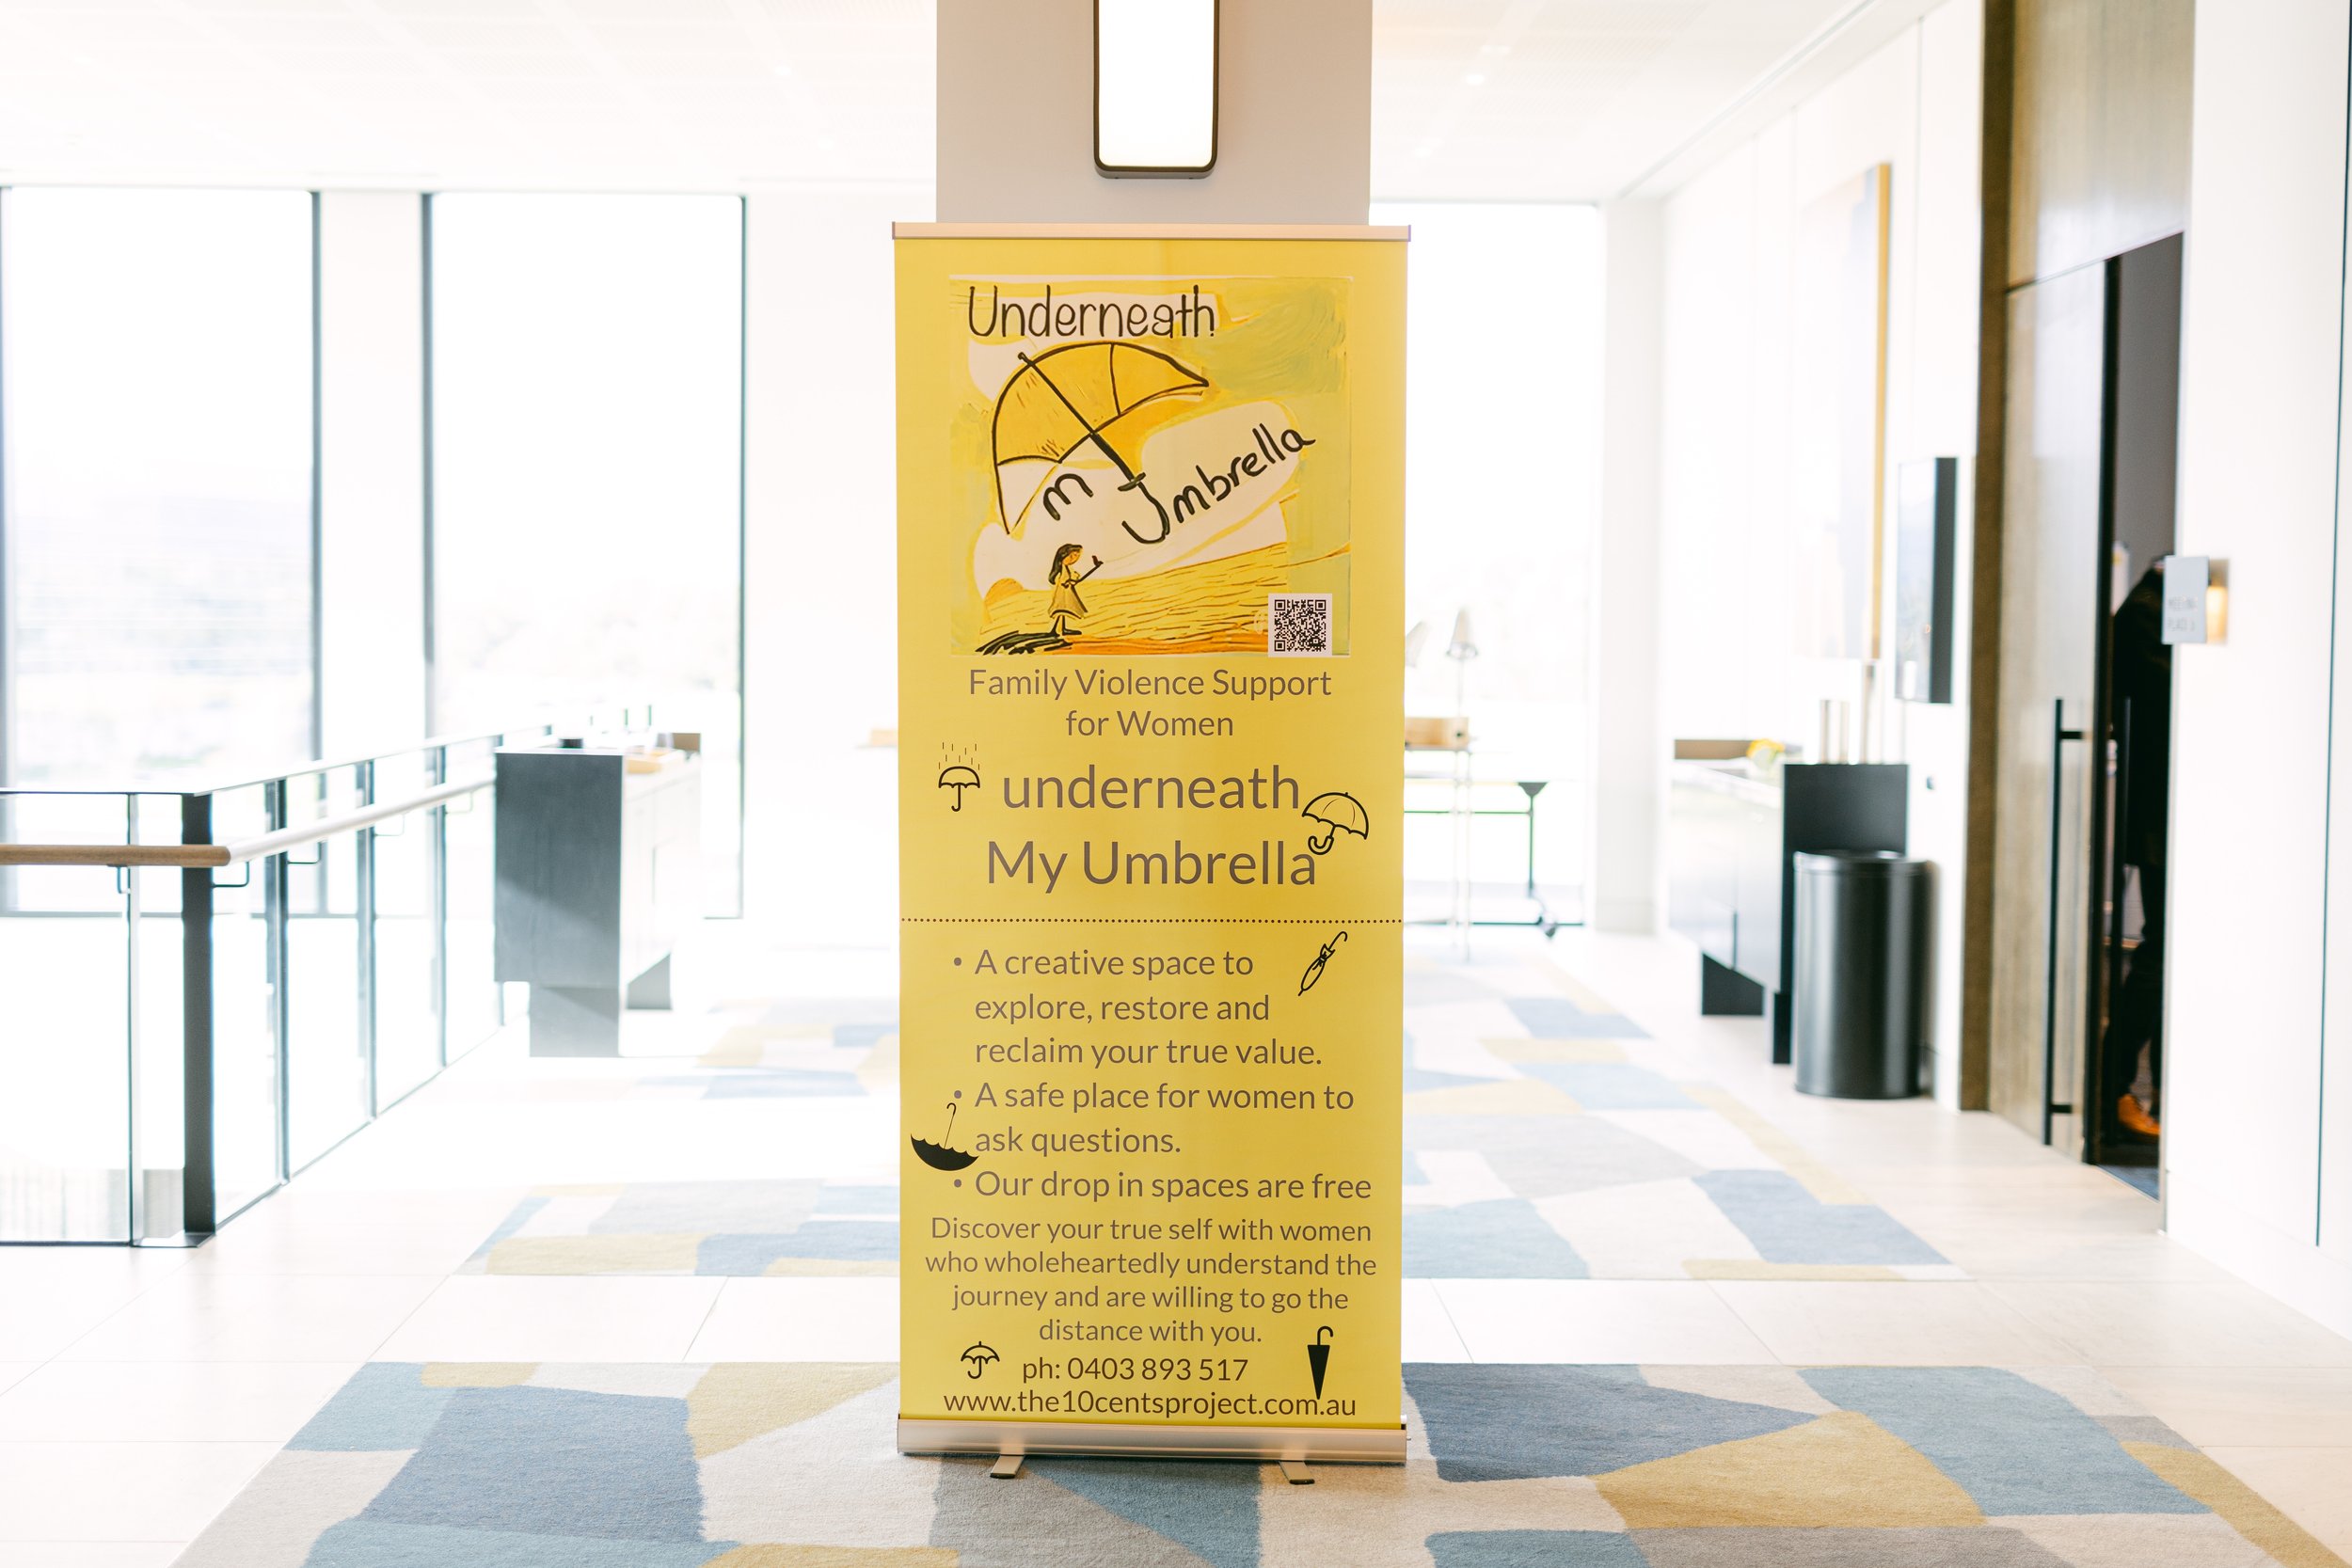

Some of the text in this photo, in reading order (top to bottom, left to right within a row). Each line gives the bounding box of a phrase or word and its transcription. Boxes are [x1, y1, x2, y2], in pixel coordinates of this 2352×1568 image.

[968, 285, 1216, 337] Underneath
[970, 668, 1332, 702] Family Violence Support
[1065, 709, 1233, 736] for Women
[1003, 764, 1299, 810] underneath
[988, 839, 1316, 895] My Umbrella
[974, 948, 1254, 980] A creative space to
[975, 992, 1269, 1025] explore, restore and
[976, 1037, 1322, 1069] reclaim your true value.
[974, 1082, 1355, 1114] A safe place for women to
[975, 1125, 1181, 1158] ask questions.
[975, 1170, 1372, 1203] Our drop in spaces are free
[931, 1216, 1372, 1244] Discover your true self with women
[925, 1250, 1377, 1279] who wholeheartedly understand the
[951, 1284, 1349, 1314] journey and are willing to go the
[1039, 1318, 1262, 1347] distance with you.
[1023, 1356, 1248, 1385] ph: 0403 893 517
[943, 1389, 1356, 1419] www.the10centsproject.com.au
